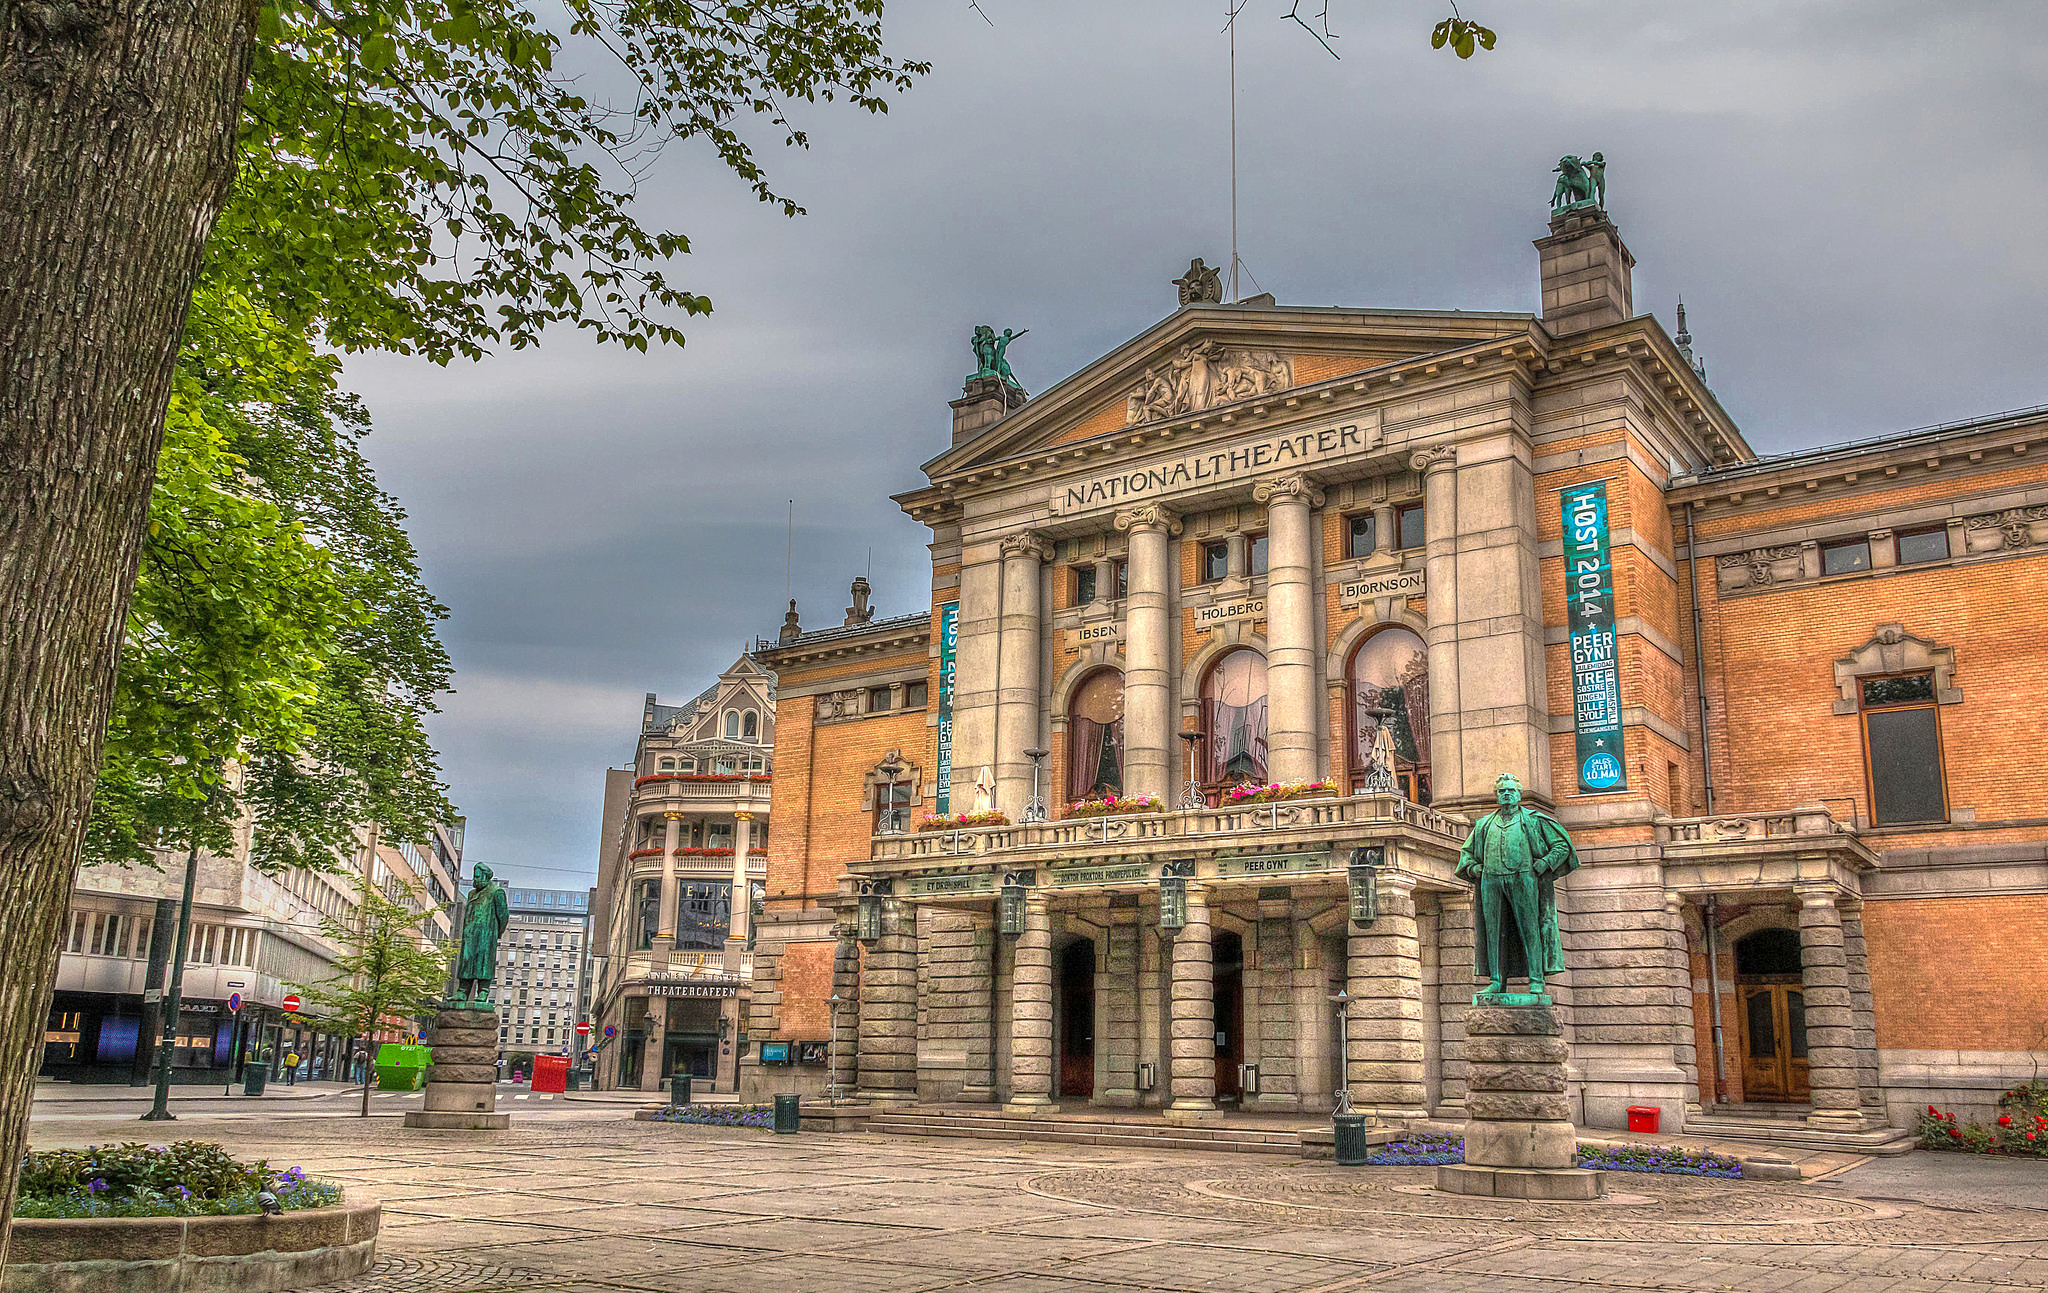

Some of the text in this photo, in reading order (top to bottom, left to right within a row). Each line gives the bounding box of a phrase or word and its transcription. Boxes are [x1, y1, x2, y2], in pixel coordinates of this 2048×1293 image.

[1066, 424, 1361, 507] NATIONALTHEATER
[1573, 493, 1603, 618] HØST 2014
[1345, 575, 1421, 598] BJØRNSON
[1201, 601, 1264, 620] HOLBERG
[1078, 625, 1118, 640] IBSEN
[1573, 631, 1613, 651] PEER
[1573, 645, 1613, 664] GYNT
[1576, 660, 1613, 672] JULEMIDDAG
[1576, 671, 1605, 685] TRE
[1577, 683, 1605, 693] SØSTRE
[1578, 693, 1604, 702] UNGEN
[1577, 701, 1605, 712] LILLE
[1578, 710, 1606, 721] EYOLF
[1244, 859, 1289, 872] PEER GYNT
[1061, 872, 1079, 883] DOKTOR
[1080, 871, 1104, 881] PROKTORS
[926, 881, 935, 891] ET
[647, 985, 736, 997] THEATERCAFEEN
